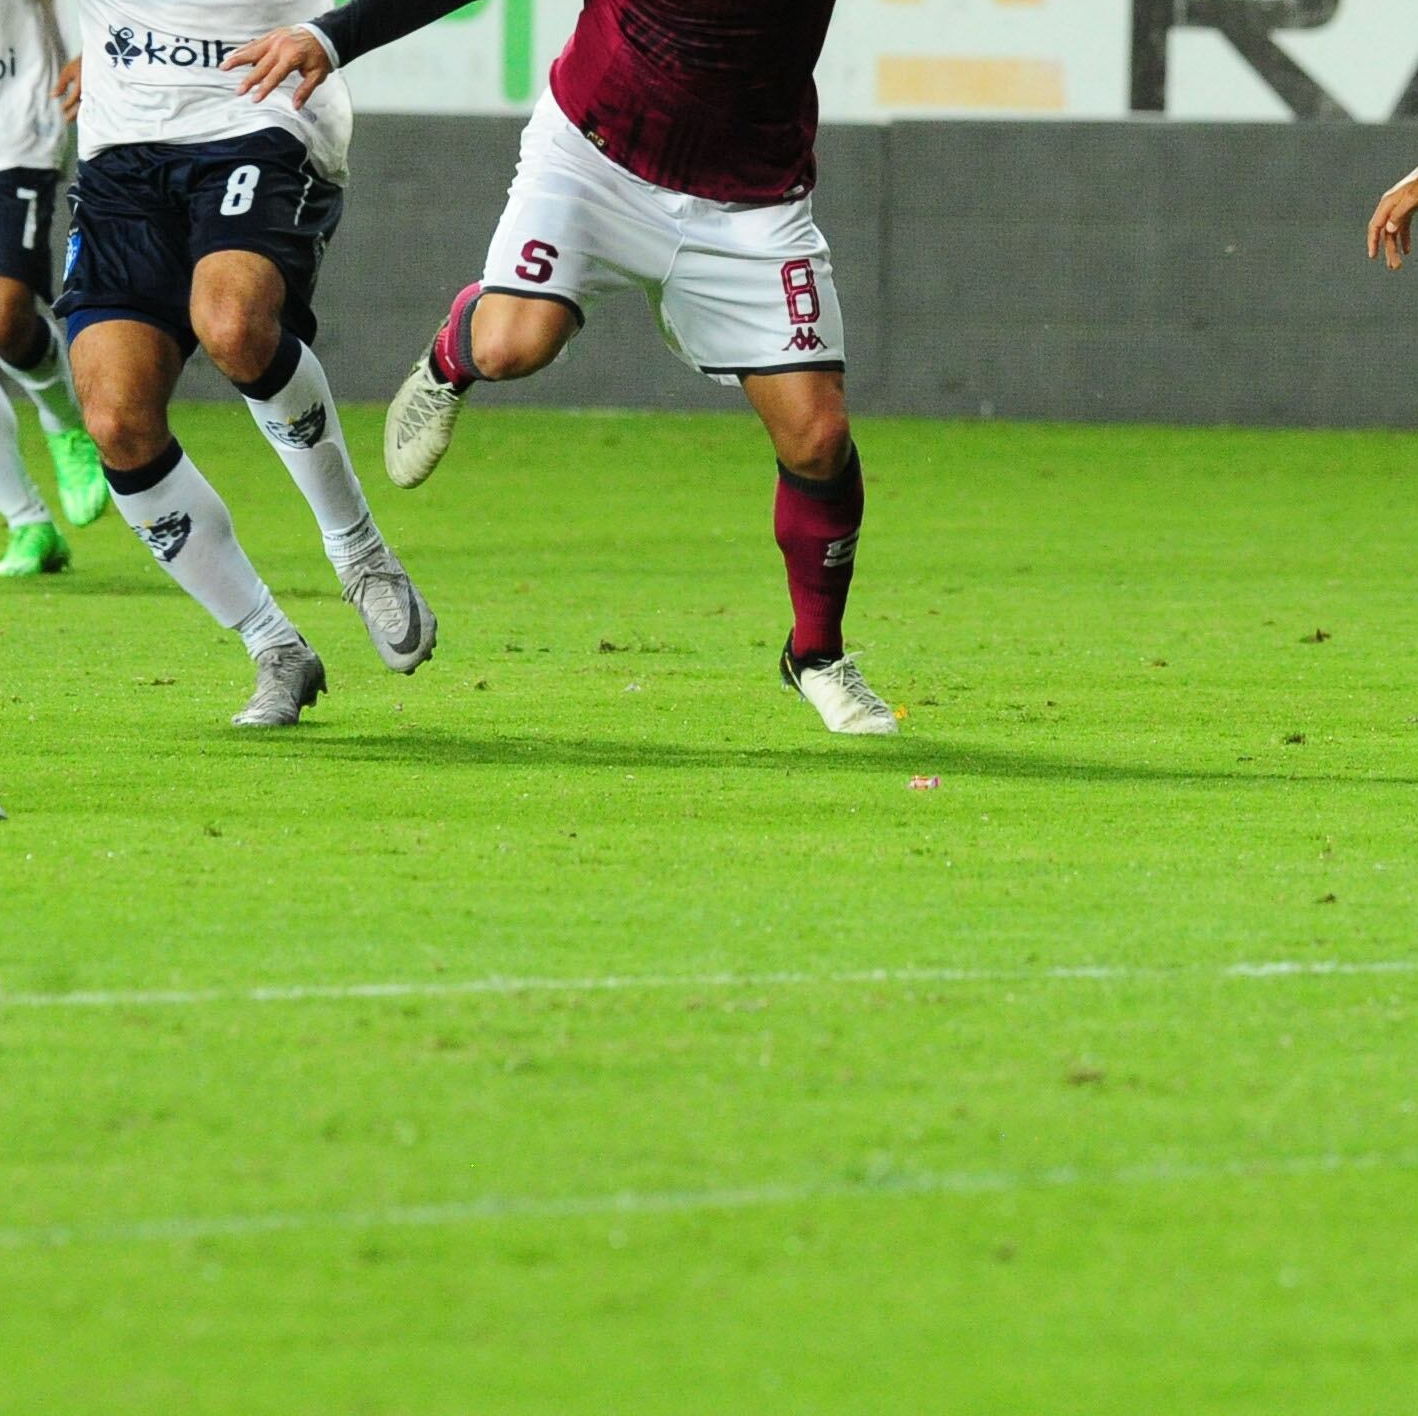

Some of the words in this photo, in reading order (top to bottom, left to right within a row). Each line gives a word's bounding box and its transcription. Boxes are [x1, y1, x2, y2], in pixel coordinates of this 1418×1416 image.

[220, 164, 261, 217] 8
[16, 187, 38, 250] 7
[514, 239, 559, 284] S
